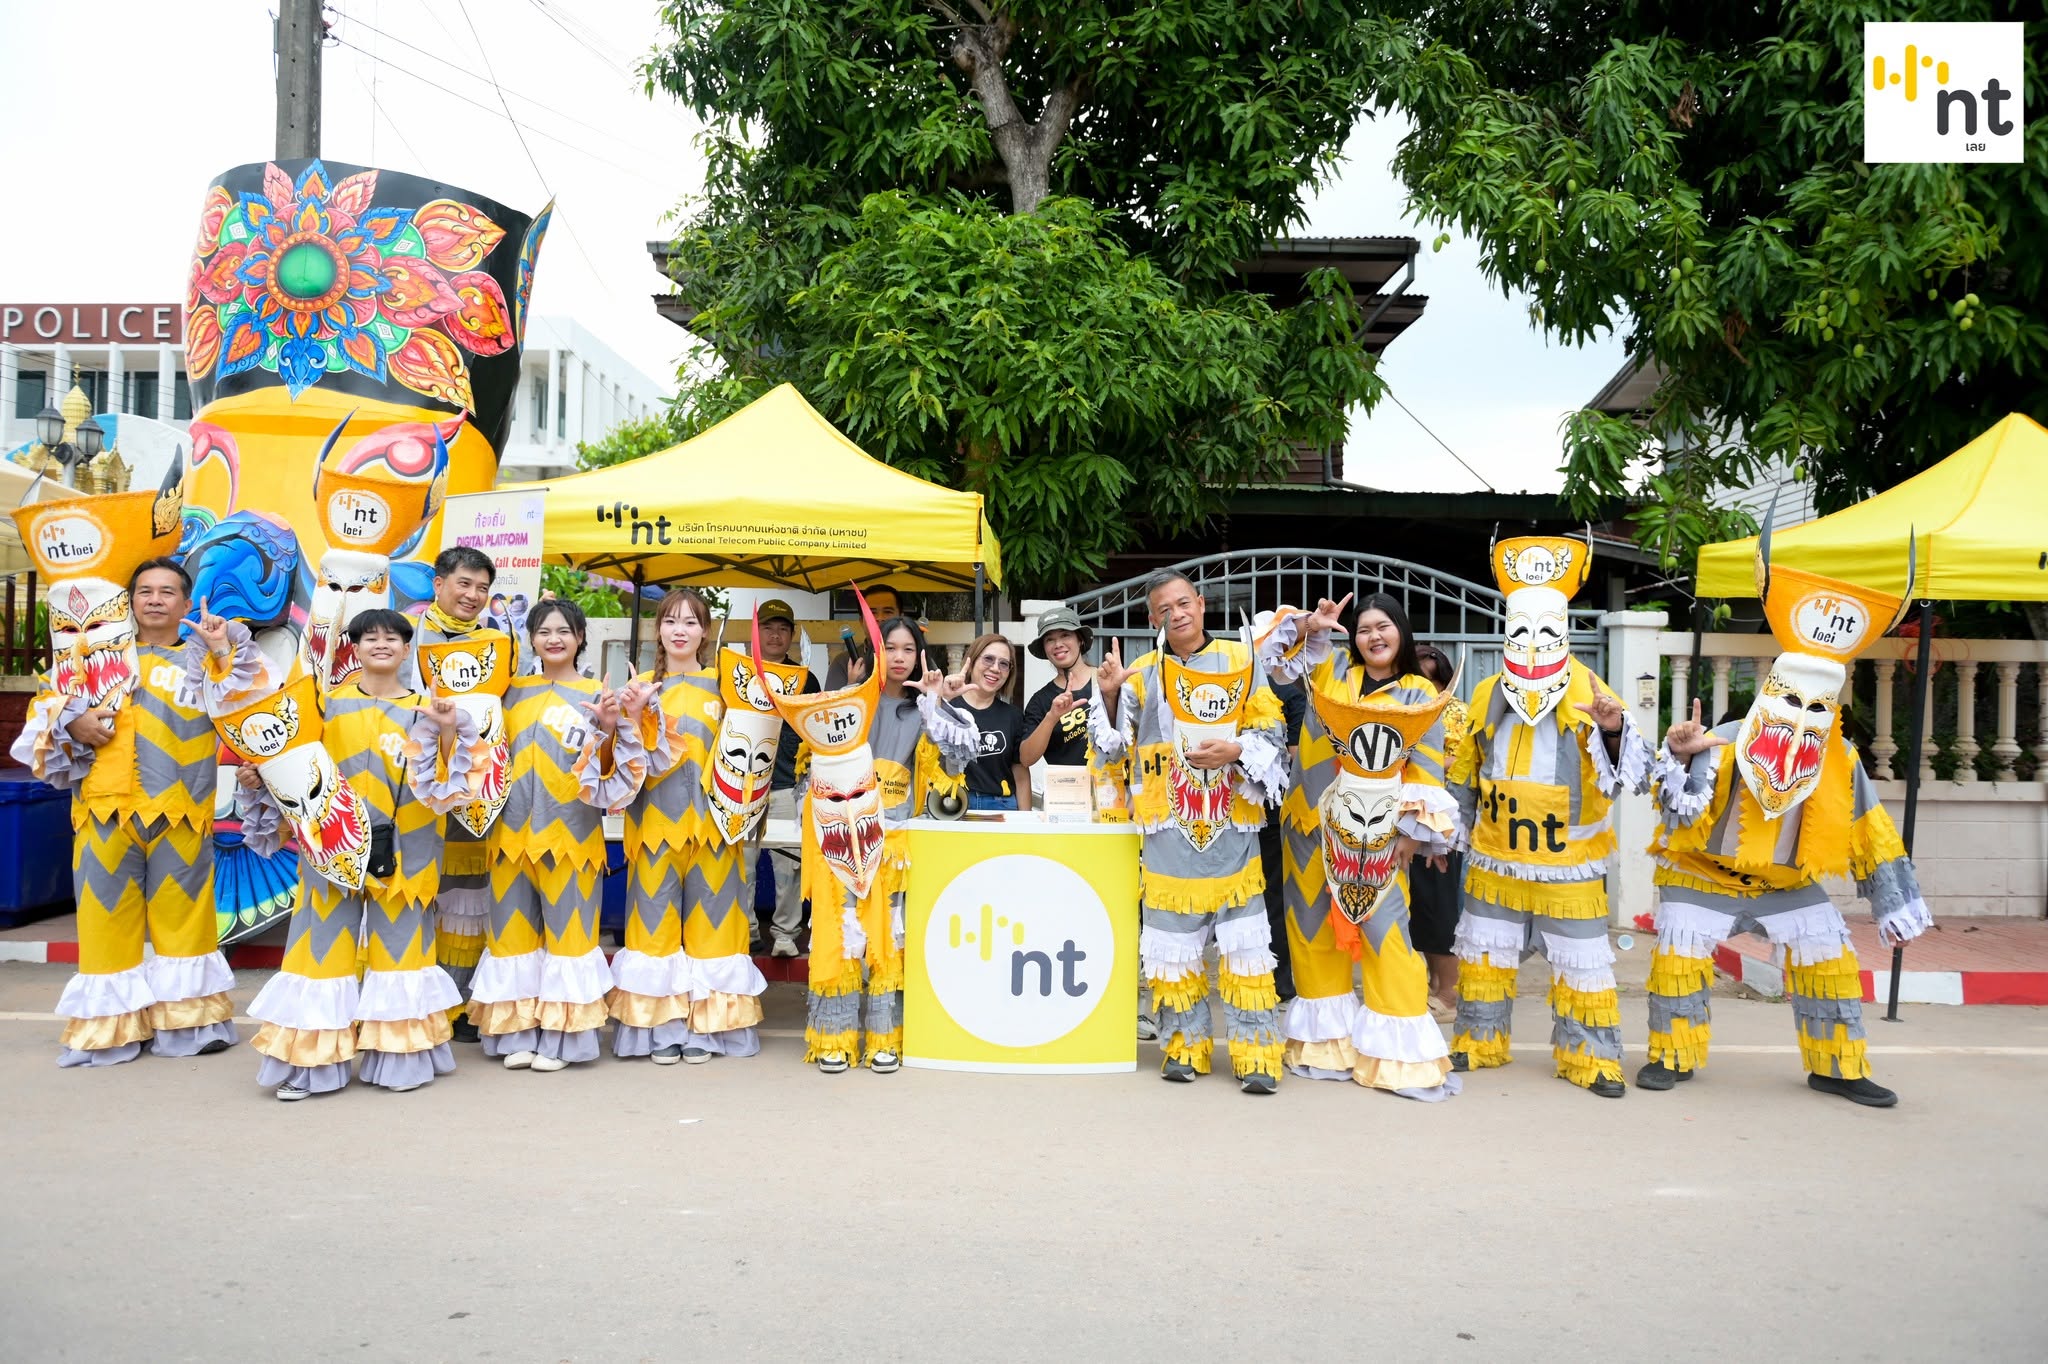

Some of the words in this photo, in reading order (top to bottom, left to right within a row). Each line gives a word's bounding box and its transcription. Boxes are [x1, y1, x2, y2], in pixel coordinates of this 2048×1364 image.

[3, 306, 172, 339] POLICE
[355, 508, 378, 524] nt
[343, 522, 362, 536] loei
[631, 515, 672, 546] nt
[678, 522, 704, 532] บริษัท
[706, 522, 799, 535] โทรคมนาคมแห่งชาติ
[801, 525, 827, 535] จำกัด
[829, 527, 868, 538] (มหาชน)
[456, 535, 484, 548] DIGITAL
[486, 532, 529, 547] PLATFORM
[677, 536, 716, 544] National
[718, 536, 756, 545] Telecom
[758, 537, 786, 546] Public
[788, 538, 830, 549] Company
[832, 540, 867, 549] Limited
[48, 541, 70, 559] nt
[71, 543, 94, 556] loei
[495, 556, 509, 568] Call
[512, 556, 541, 568] Center
[1534, 561, 1552, 573] nt
[1525, 573, 1543, 581] loei
[1830, 615, 1856, 633] nt
[1812, 626, 1836, 643] loei
[460, 665, 478, 678] nt
[452, 679, 470, 688] loei
[1208, 697, 1226, 710] nt
[834, 712, 856, 731] nt
[1060, 707, 1086, 732] 5G
[1199, 709, 1217, 719] loei
[262, 723, 284, 741] nt
[827, 730, 847, 743] loei
[260, 739, 280, 753] loei
[1350, 724, 1401, 770] NT
[1109, 815, 1118, 823] nt
[1509, 813, 1566, 853] nt
[1010, 939, 1088, 998] nt
